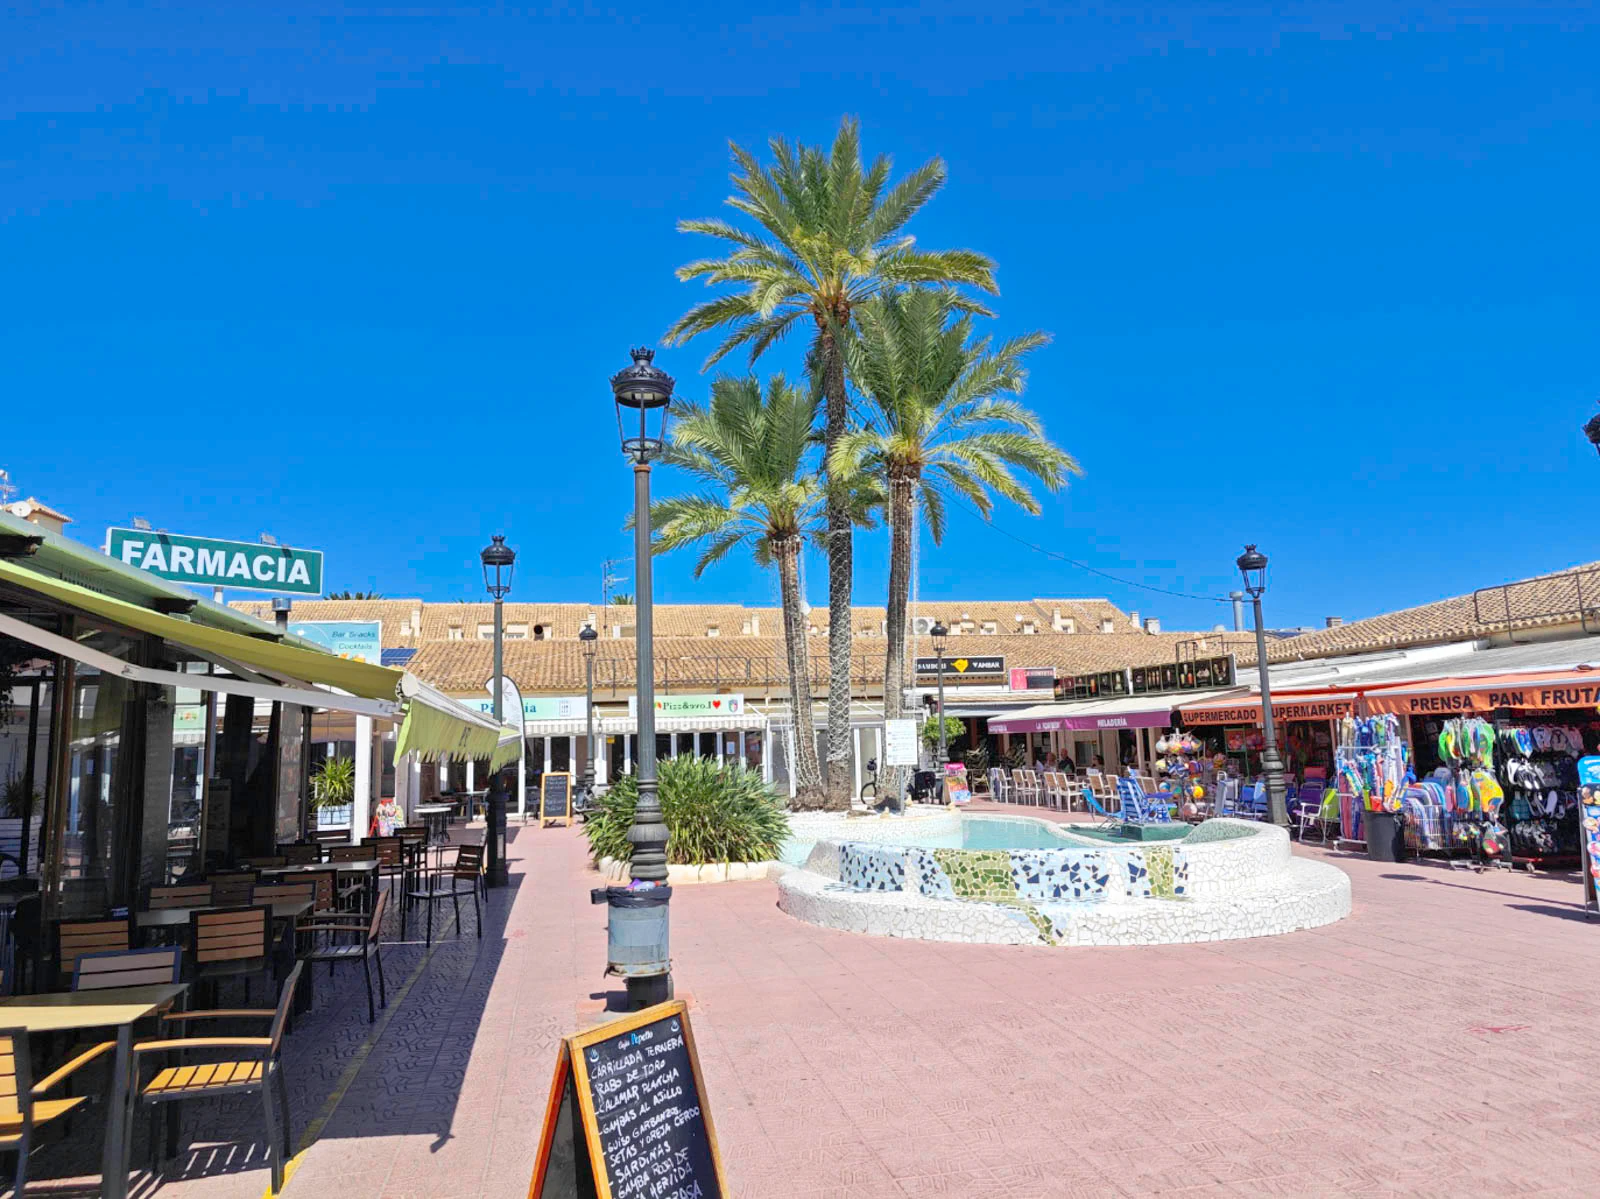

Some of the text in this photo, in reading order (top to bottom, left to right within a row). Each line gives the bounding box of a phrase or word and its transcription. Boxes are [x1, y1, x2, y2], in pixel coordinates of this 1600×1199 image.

[121, 540, 311, 585] FARMACIA
[338, 642, 373, 650] Cocktails
[349, 630, 376, 638] Snacks
[1183, 703, 1351, 722] SUPERMERCADO UPERMARKET
[1410, 695, 1474, 711] PRENSA
[1489, 692, 1524, 707] PAN
[626, 1069, 639, 1083] DE
[642, 1059, 666, 1078] TORO
[599, 1085, 640, 1112] CALAMAR
[603, 1109, 637, 1136] GAMBAS
[639, 1102, 651, 1116] AL
[609, 1144, 637, 1168] SETAS
[646, 1122, 671, 1144] OREJA
[674, 1106, 700, 1127] CERDO
[618, 1170, 650, 1199] GAMBA
[674, 1147, 689, 1165] DE
